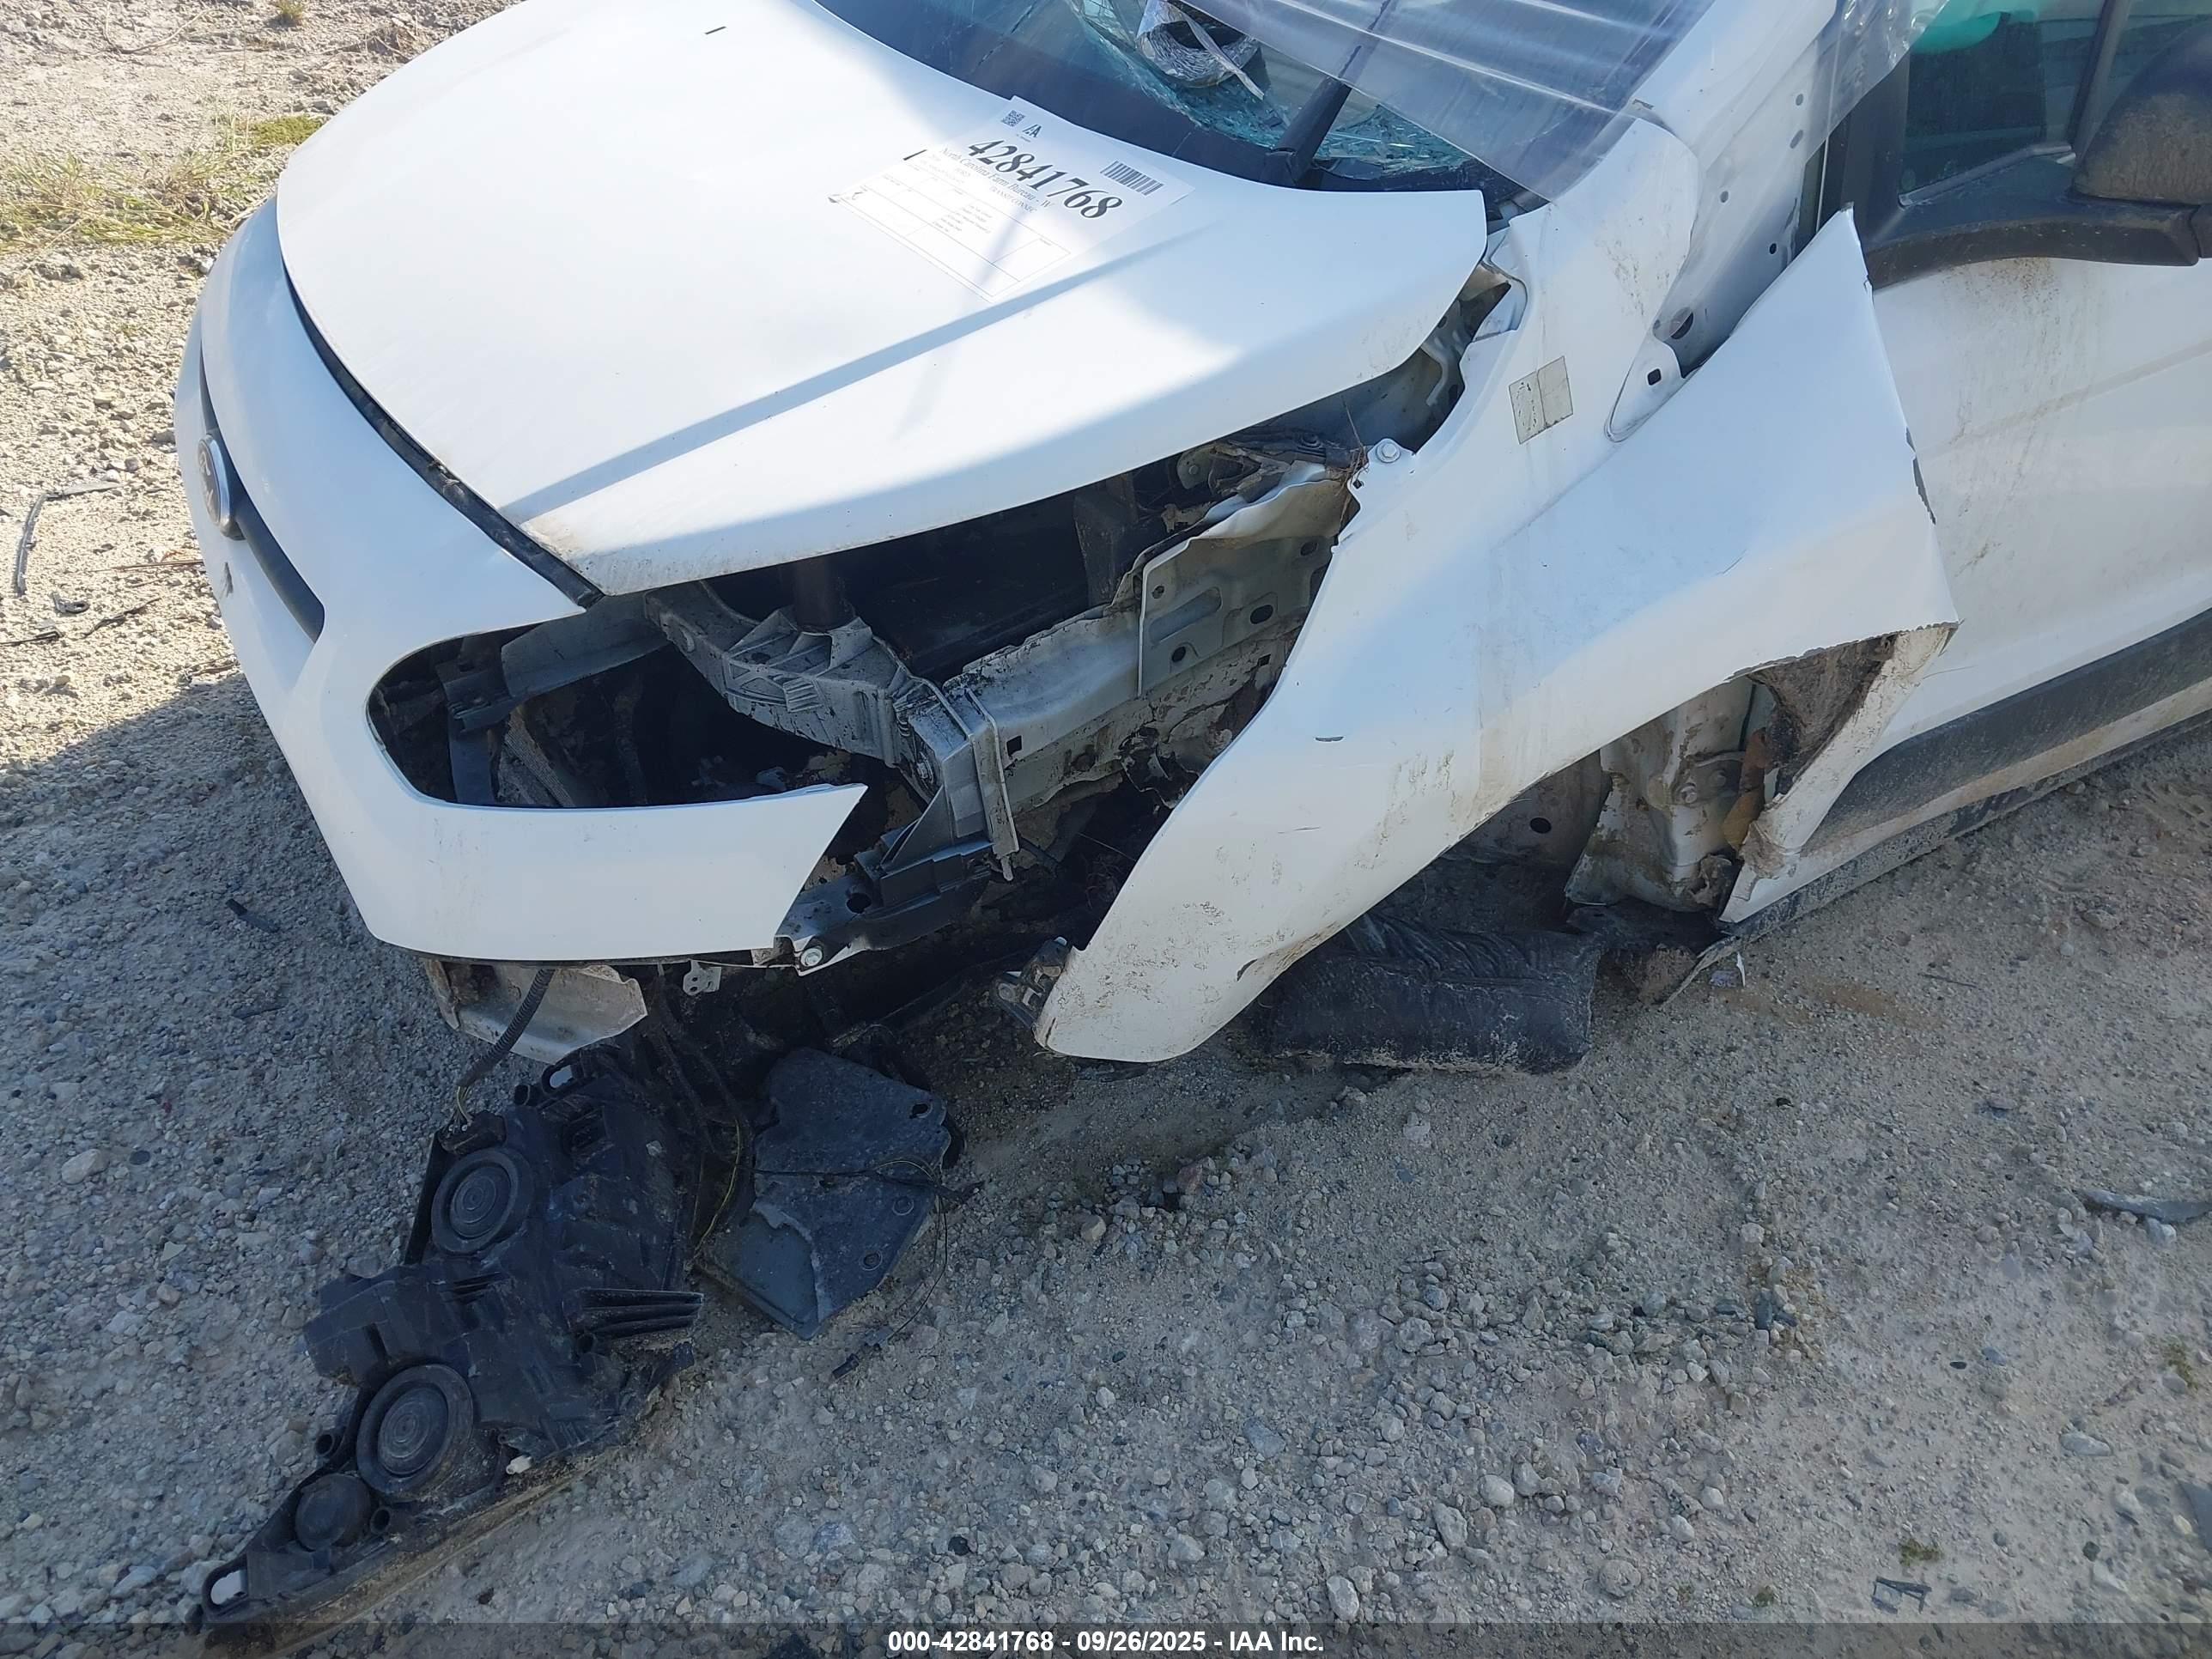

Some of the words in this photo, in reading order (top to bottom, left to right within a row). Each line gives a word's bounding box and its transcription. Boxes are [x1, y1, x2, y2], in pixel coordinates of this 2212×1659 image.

[939, 147, 963, 161] North
[959, 158, 992, 177] Carolina
[988, 173, 1012, 187] Farm
[1007, 183, 1037, 201] Bureau
[968, 139, 1123, 219] 42841768
